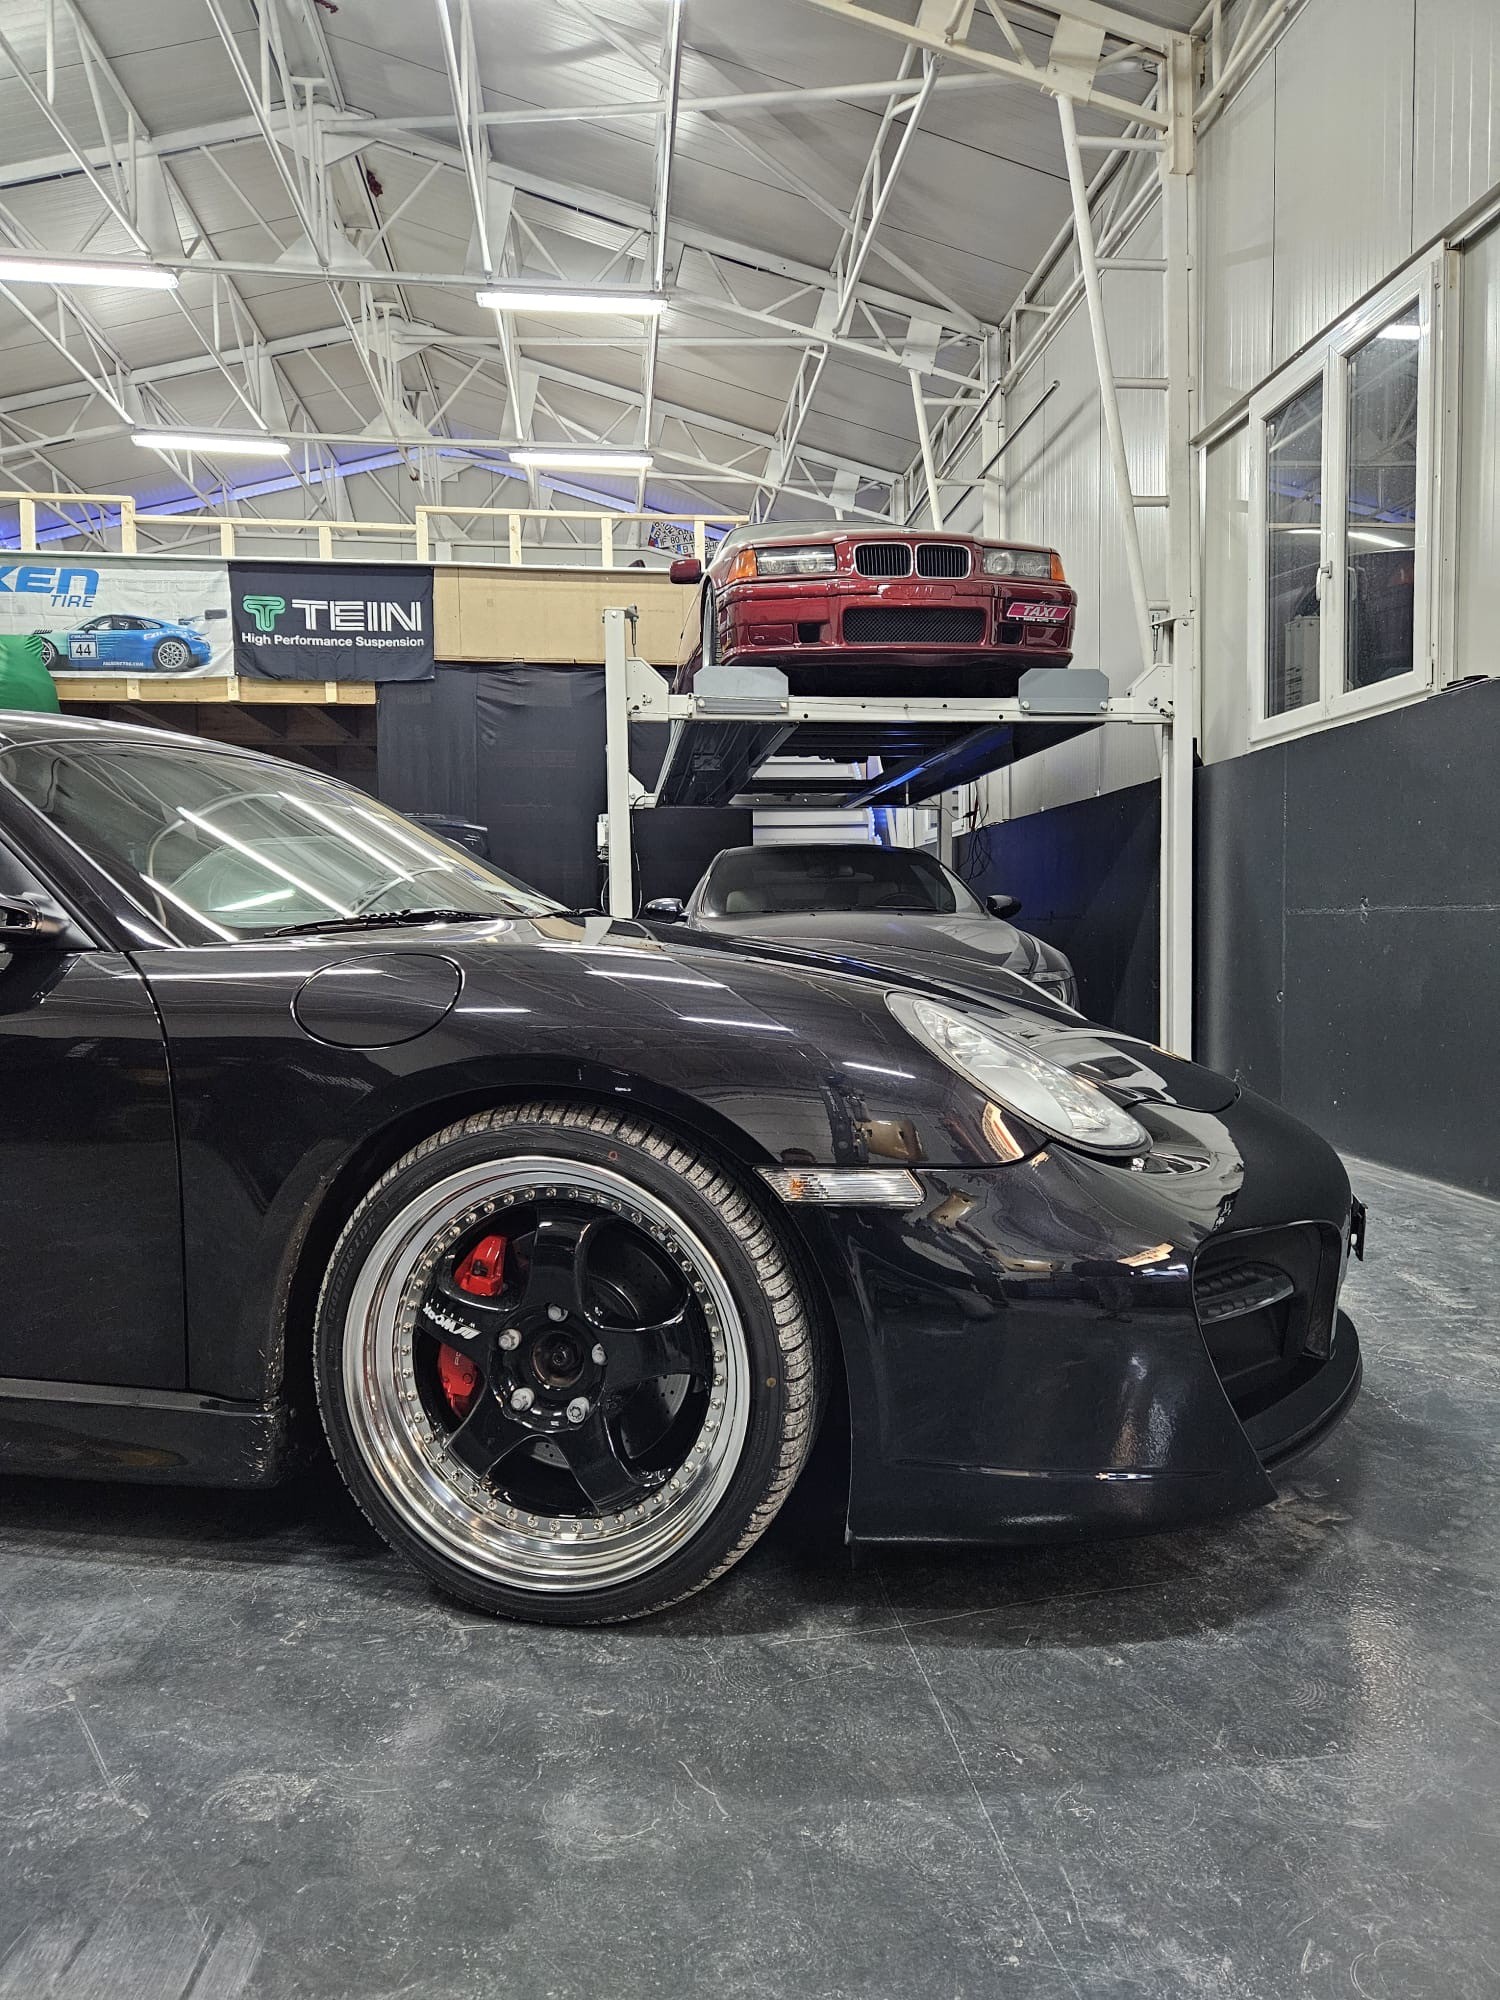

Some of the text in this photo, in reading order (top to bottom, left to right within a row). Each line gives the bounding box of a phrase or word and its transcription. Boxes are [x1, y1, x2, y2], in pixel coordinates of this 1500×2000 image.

[670, 536, 680, 544] 80
[51, 595, 96, 608] TIRE
[292, 599, 422, 632] TEIN
[1023, 605, 1057, 617] TAXI
[242, 632, 425, 649] High Performance Suspension
[75, 643, 92, 657] 44
[422, 1302, 474, 1339] WORK
